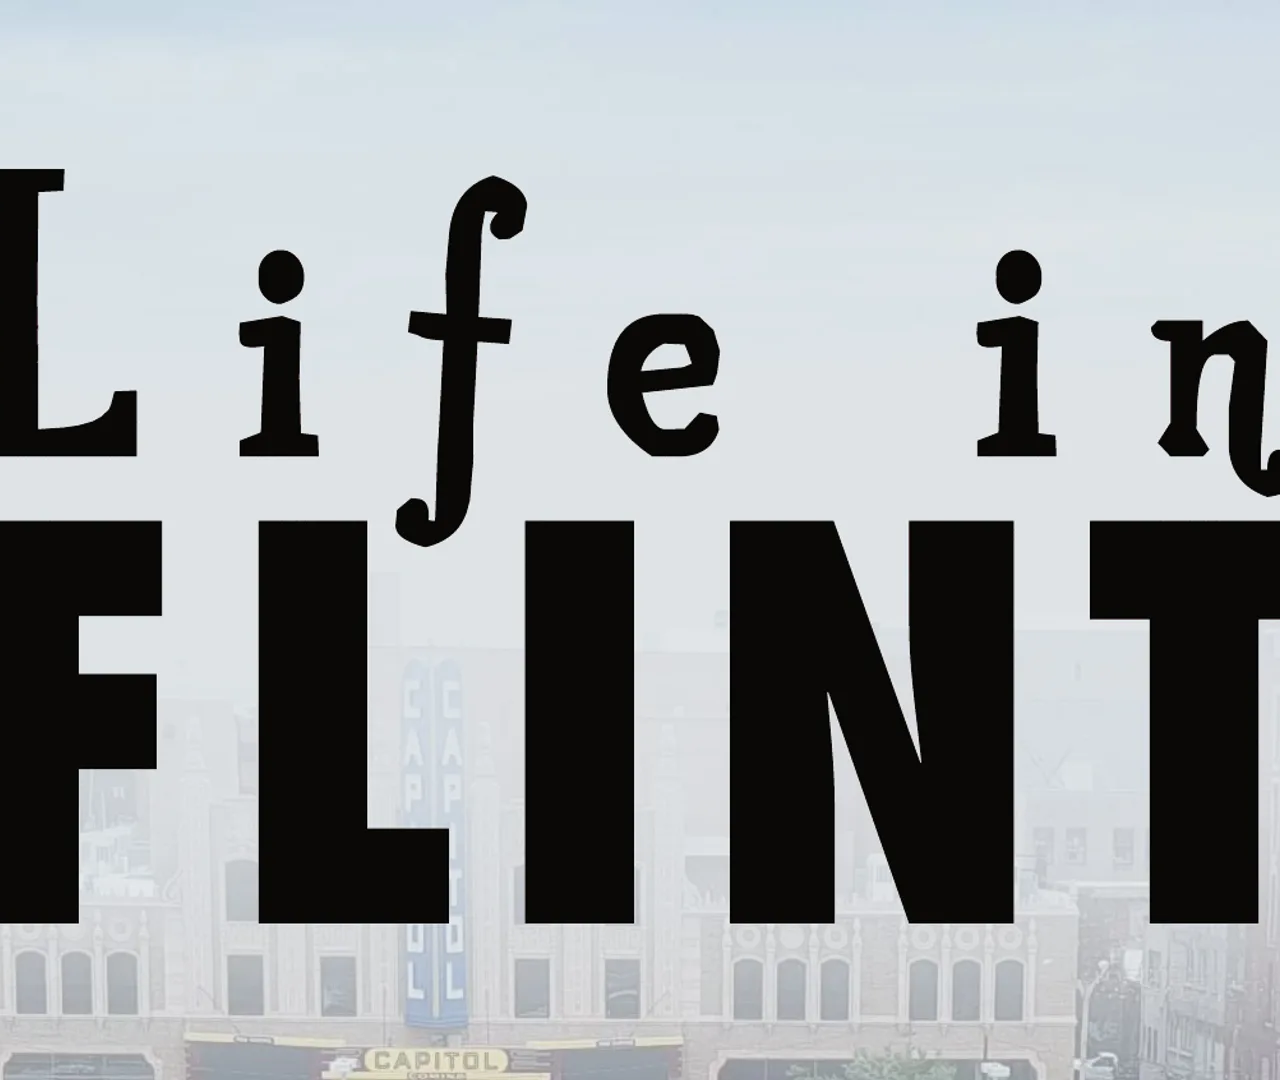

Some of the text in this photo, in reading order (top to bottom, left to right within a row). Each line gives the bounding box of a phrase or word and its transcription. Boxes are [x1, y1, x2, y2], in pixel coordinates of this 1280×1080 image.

[403, 680, 425, 999] CAPOL
[442, 680, 465, 1000] CAPITOL
[374, 1051, 499, 1071] CAPITOL
